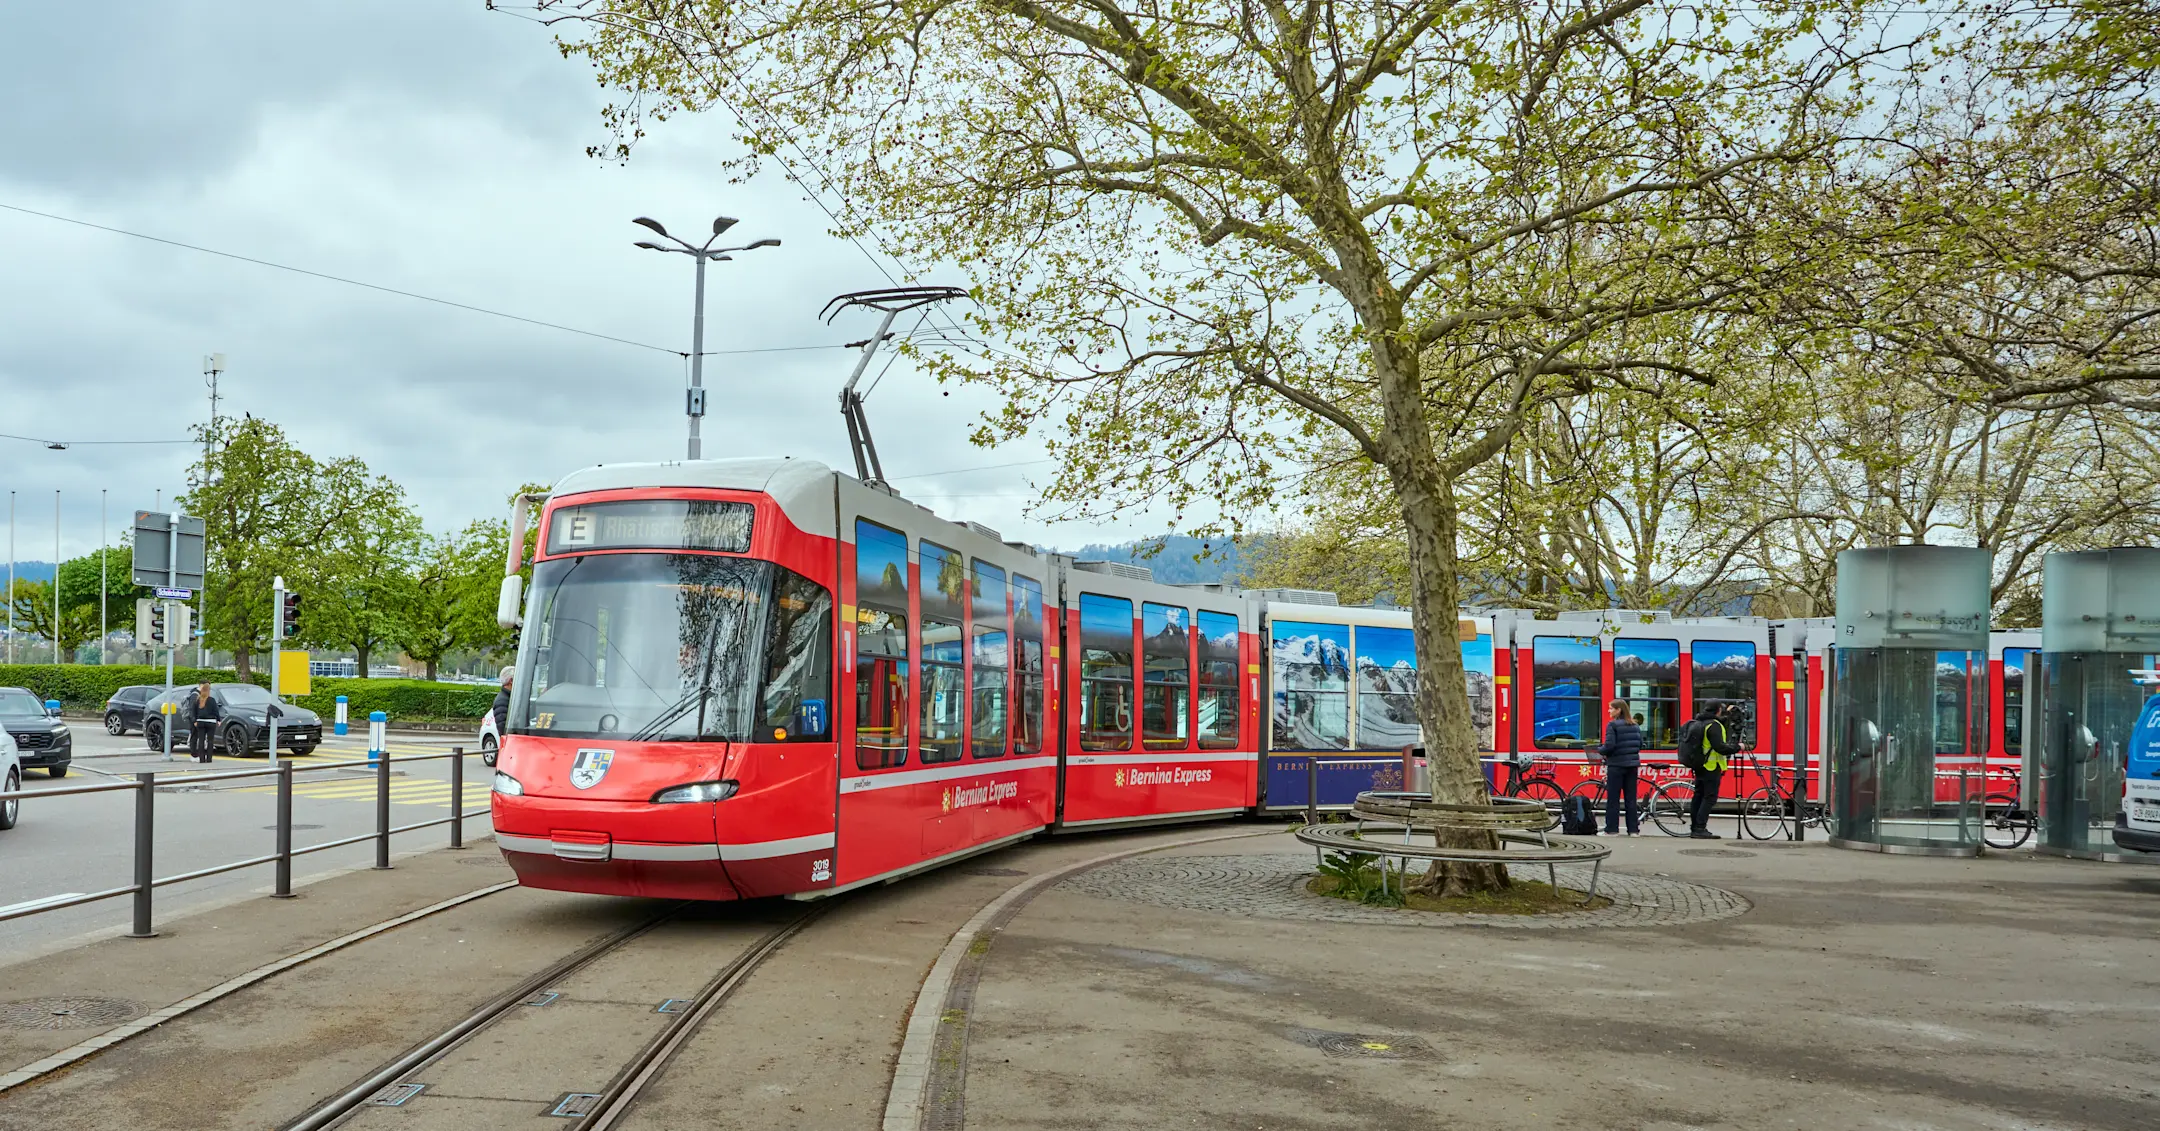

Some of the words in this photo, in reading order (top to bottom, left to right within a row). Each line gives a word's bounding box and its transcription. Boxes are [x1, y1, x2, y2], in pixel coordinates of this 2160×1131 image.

[569, 517, 587, 541] E
[1130, 766, 1172, 785] Bernina
[1174, 767, 1212, 786] Express
[954, 781, 988, 809] Bernina
[989, 780, 1018, 805] Express
[813, 859, 830, 871] 3019
